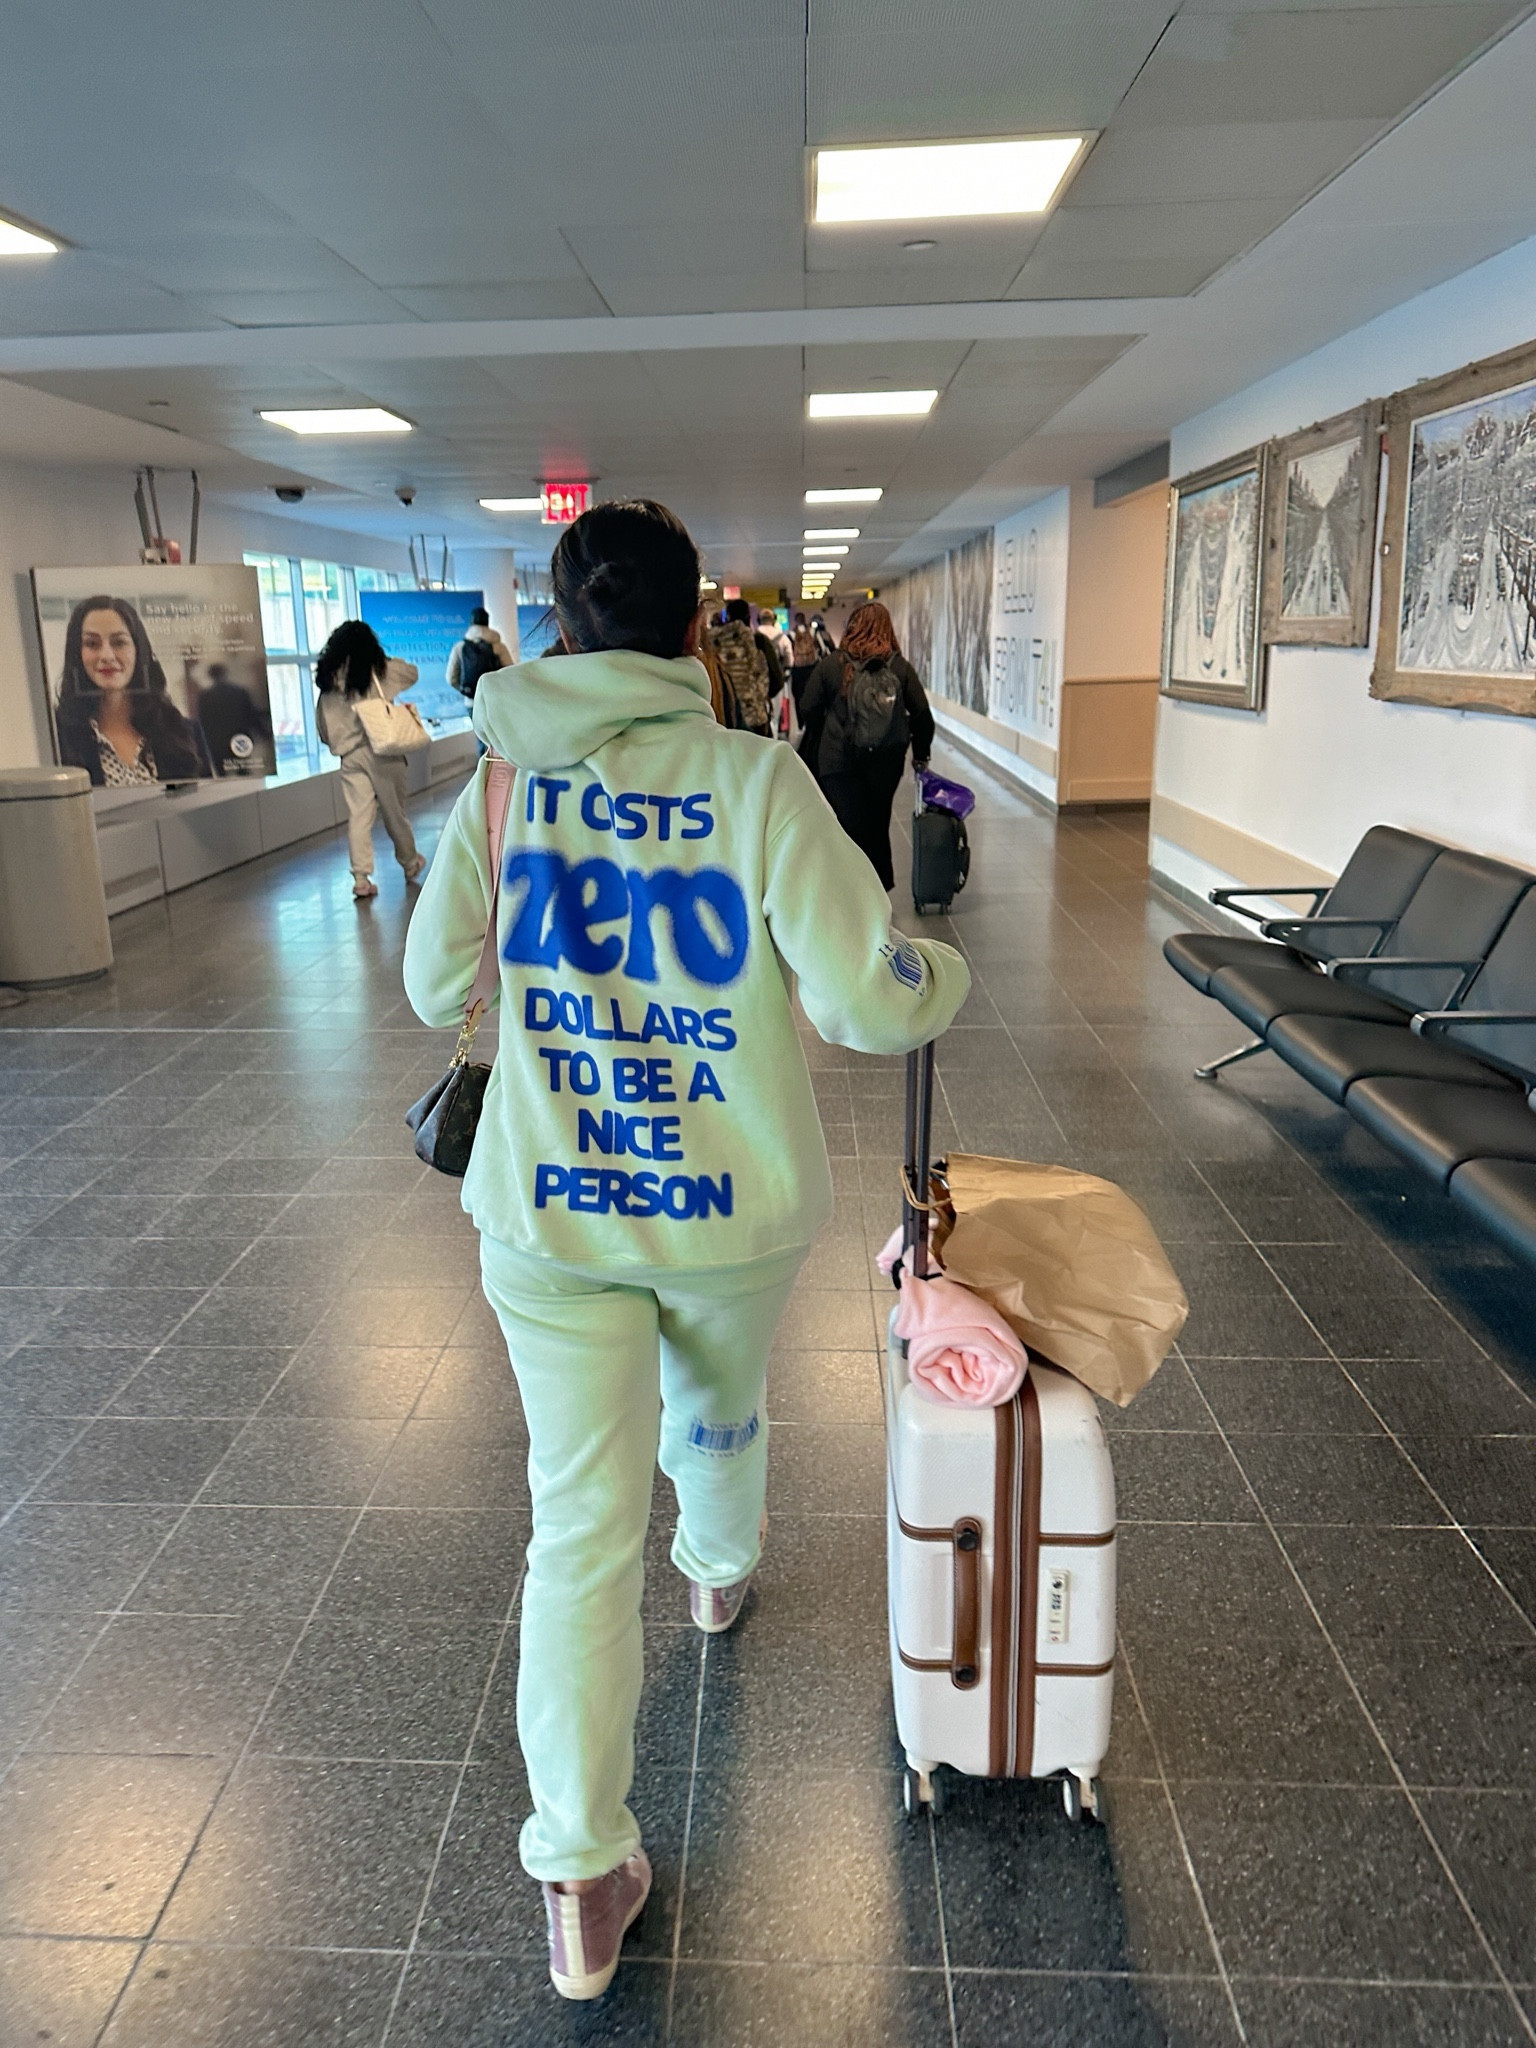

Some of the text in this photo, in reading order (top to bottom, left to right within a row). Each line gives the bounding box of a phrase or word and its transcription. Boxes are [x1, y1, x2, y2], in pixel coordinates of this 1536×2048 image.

[545, 483, 588, 521] EXIT
[145, 603, 168, 615] Say
[170, 602, 200, 614] hello
[220, 602, 239, 613] the
[526, 776, 571, 824] IT
[503, 846, 749, 990] zero
[525, 987, 737, 1051] DOLLARS
[539, 1048, 726, 1103] TO BE A
[578, 1108, 683, 1161] NICE
[534, 1163, 734, 1220] PERSON
